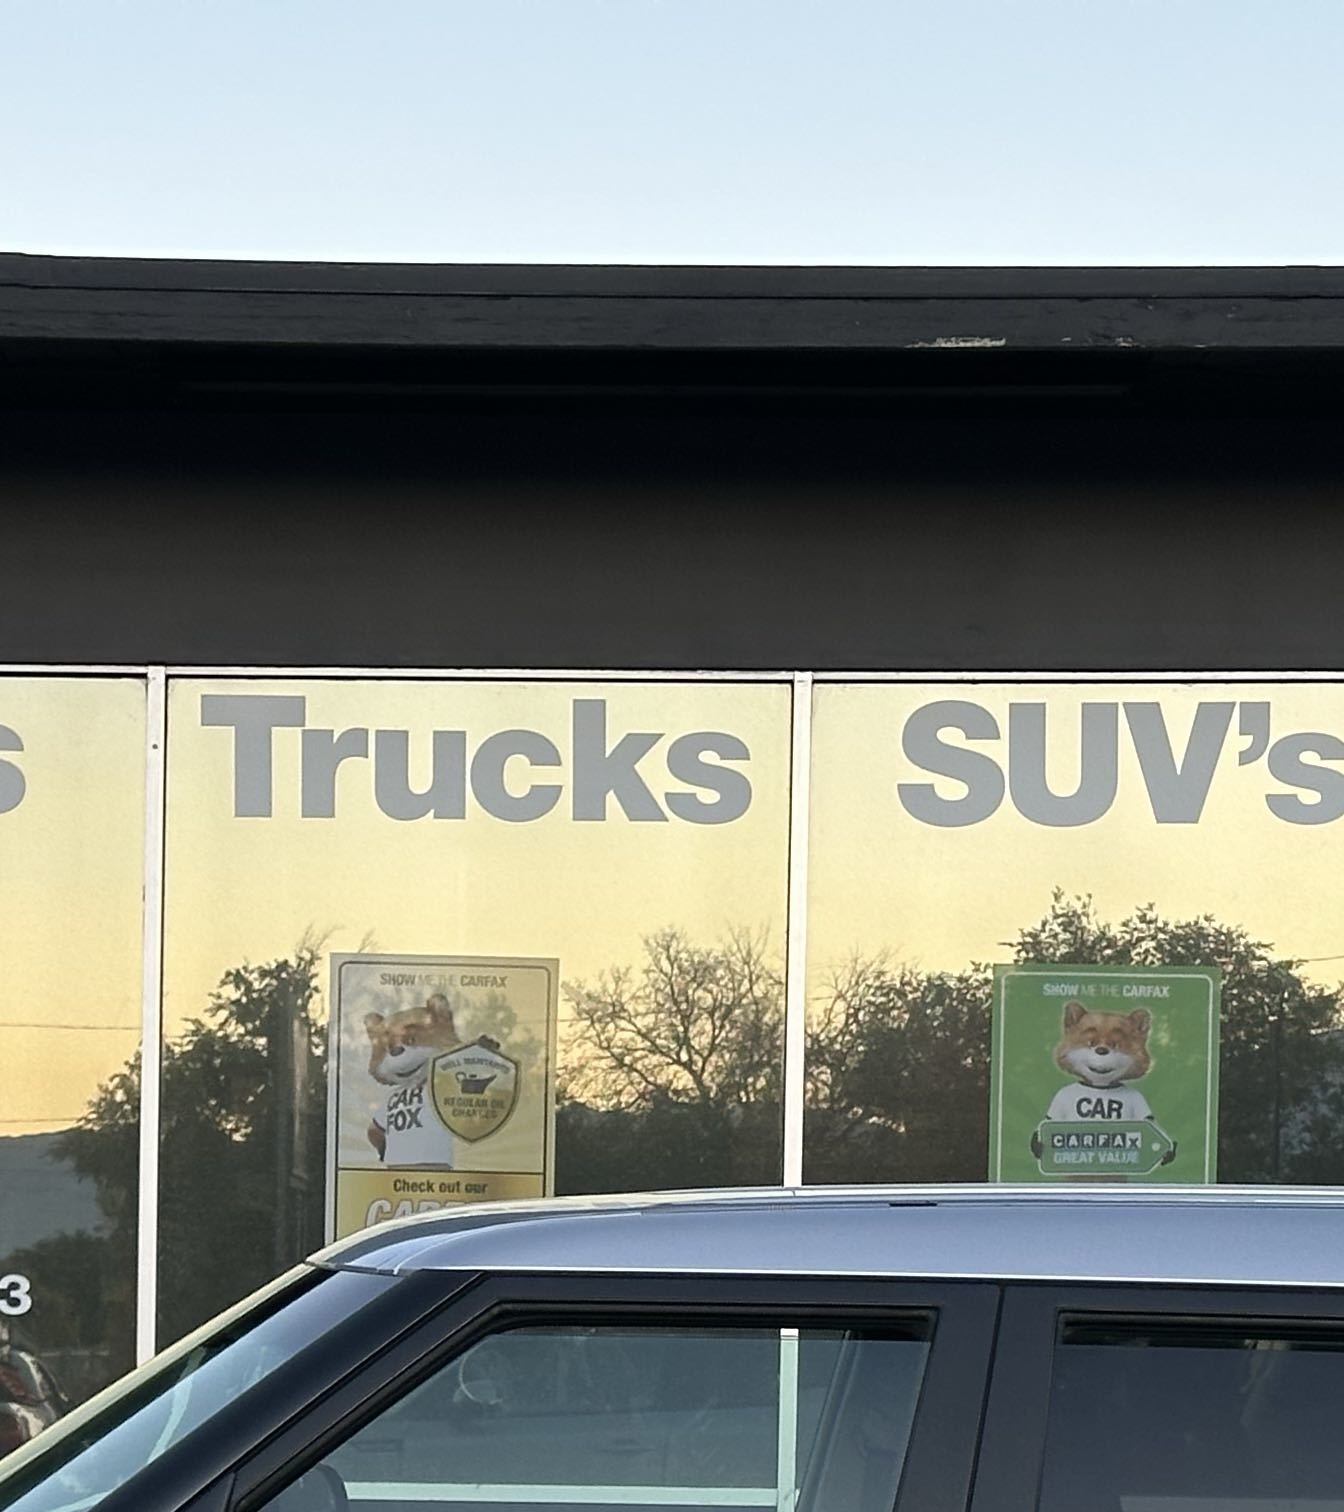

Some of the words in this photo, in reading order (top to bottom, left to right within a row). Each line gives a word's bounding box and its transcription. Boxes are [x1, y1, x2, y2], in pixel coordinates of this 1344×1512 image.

[200, 693, 754, 826] Trucks
[379, 972, 417, 986] SHOW
[460, 974, 509, 988] CARFAX
[1043, 983, 1079, 996] SHOW
[1123, 984, 1170, 998] CARFAX
[387, 1087, 424, 1113] CAR
[1076, 1097, 1123, 1120] CAR
[386, 1107, 424, 1135] FOX
[1052, 1132, 1142, 1149] CARFAX
[1054, 1151, 1094, 1164] GREAT
[1099, 1151, 1141, 1165] VALUE
[393, 1179, 435, 1193] Check
[439, 1181, 460, 1194] out
